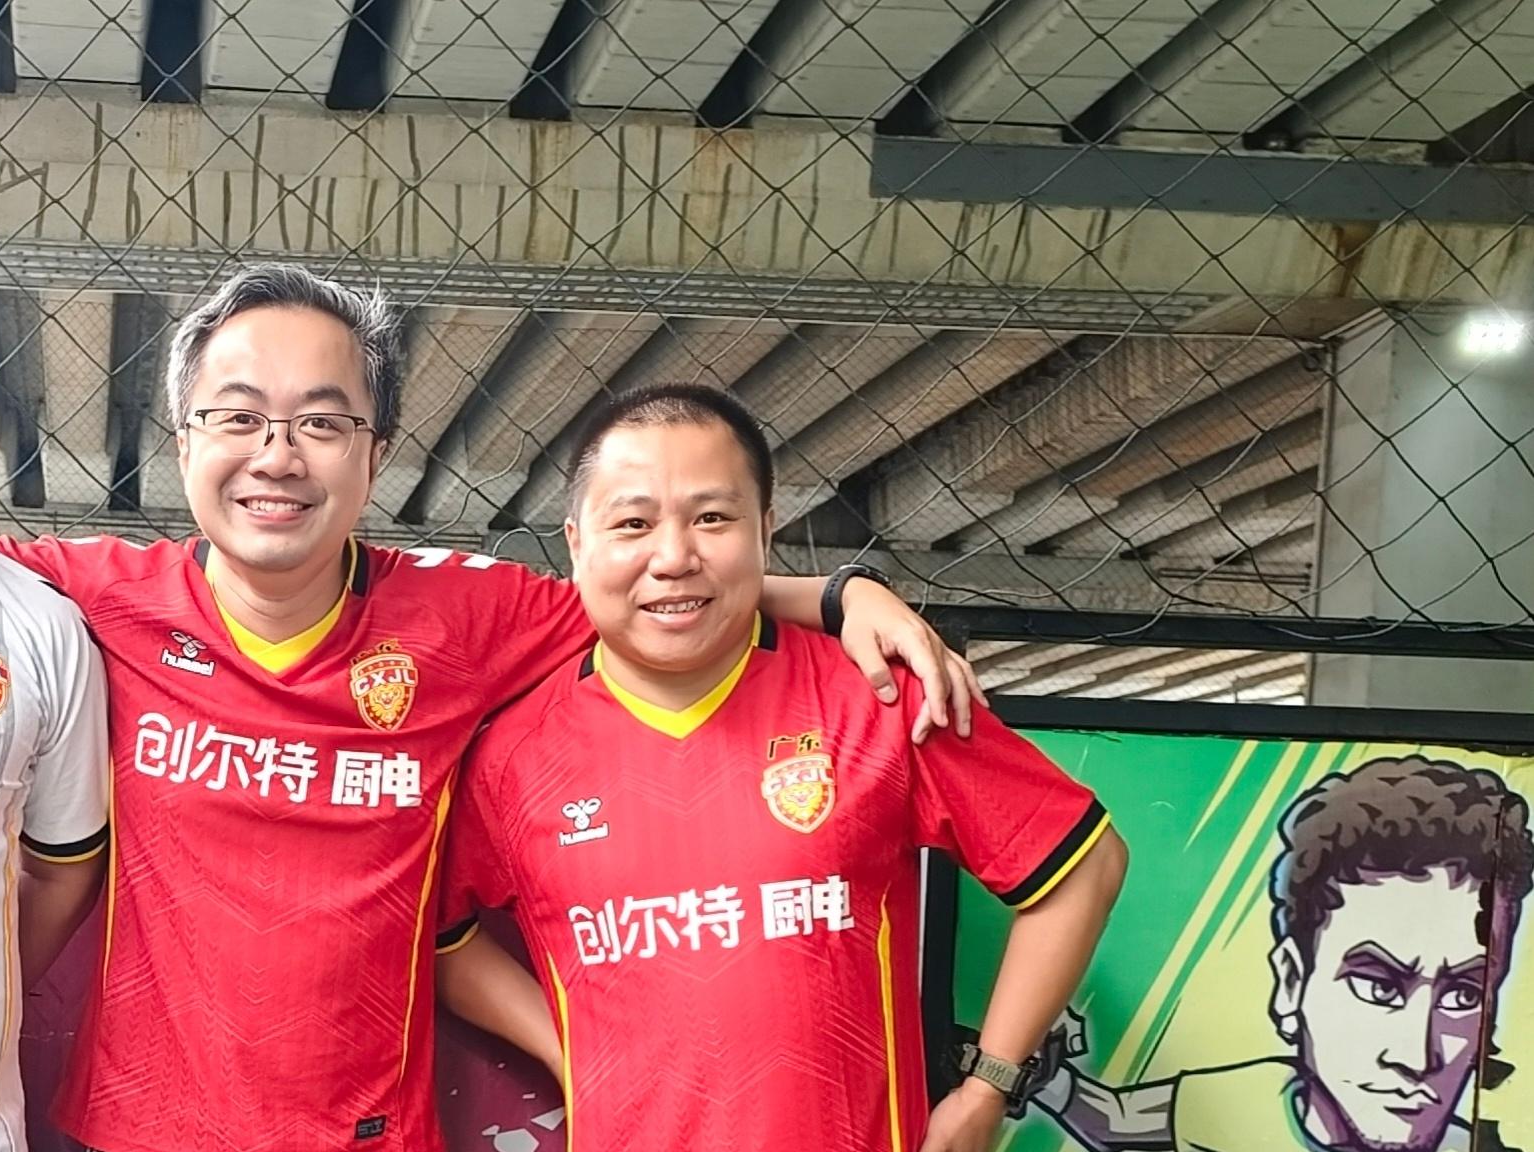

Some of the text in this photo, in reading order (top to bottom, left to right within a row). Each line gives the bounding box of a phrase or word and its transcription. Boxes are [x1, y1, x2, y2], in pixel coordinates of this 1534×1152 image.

[161, 648, 215, 677] hummel
[354, 668, 416, 698] CXJL
[134, 711, 423, 808] 创尔特 厨电
[567, 874, 855, 966] 创尔特 厨电
